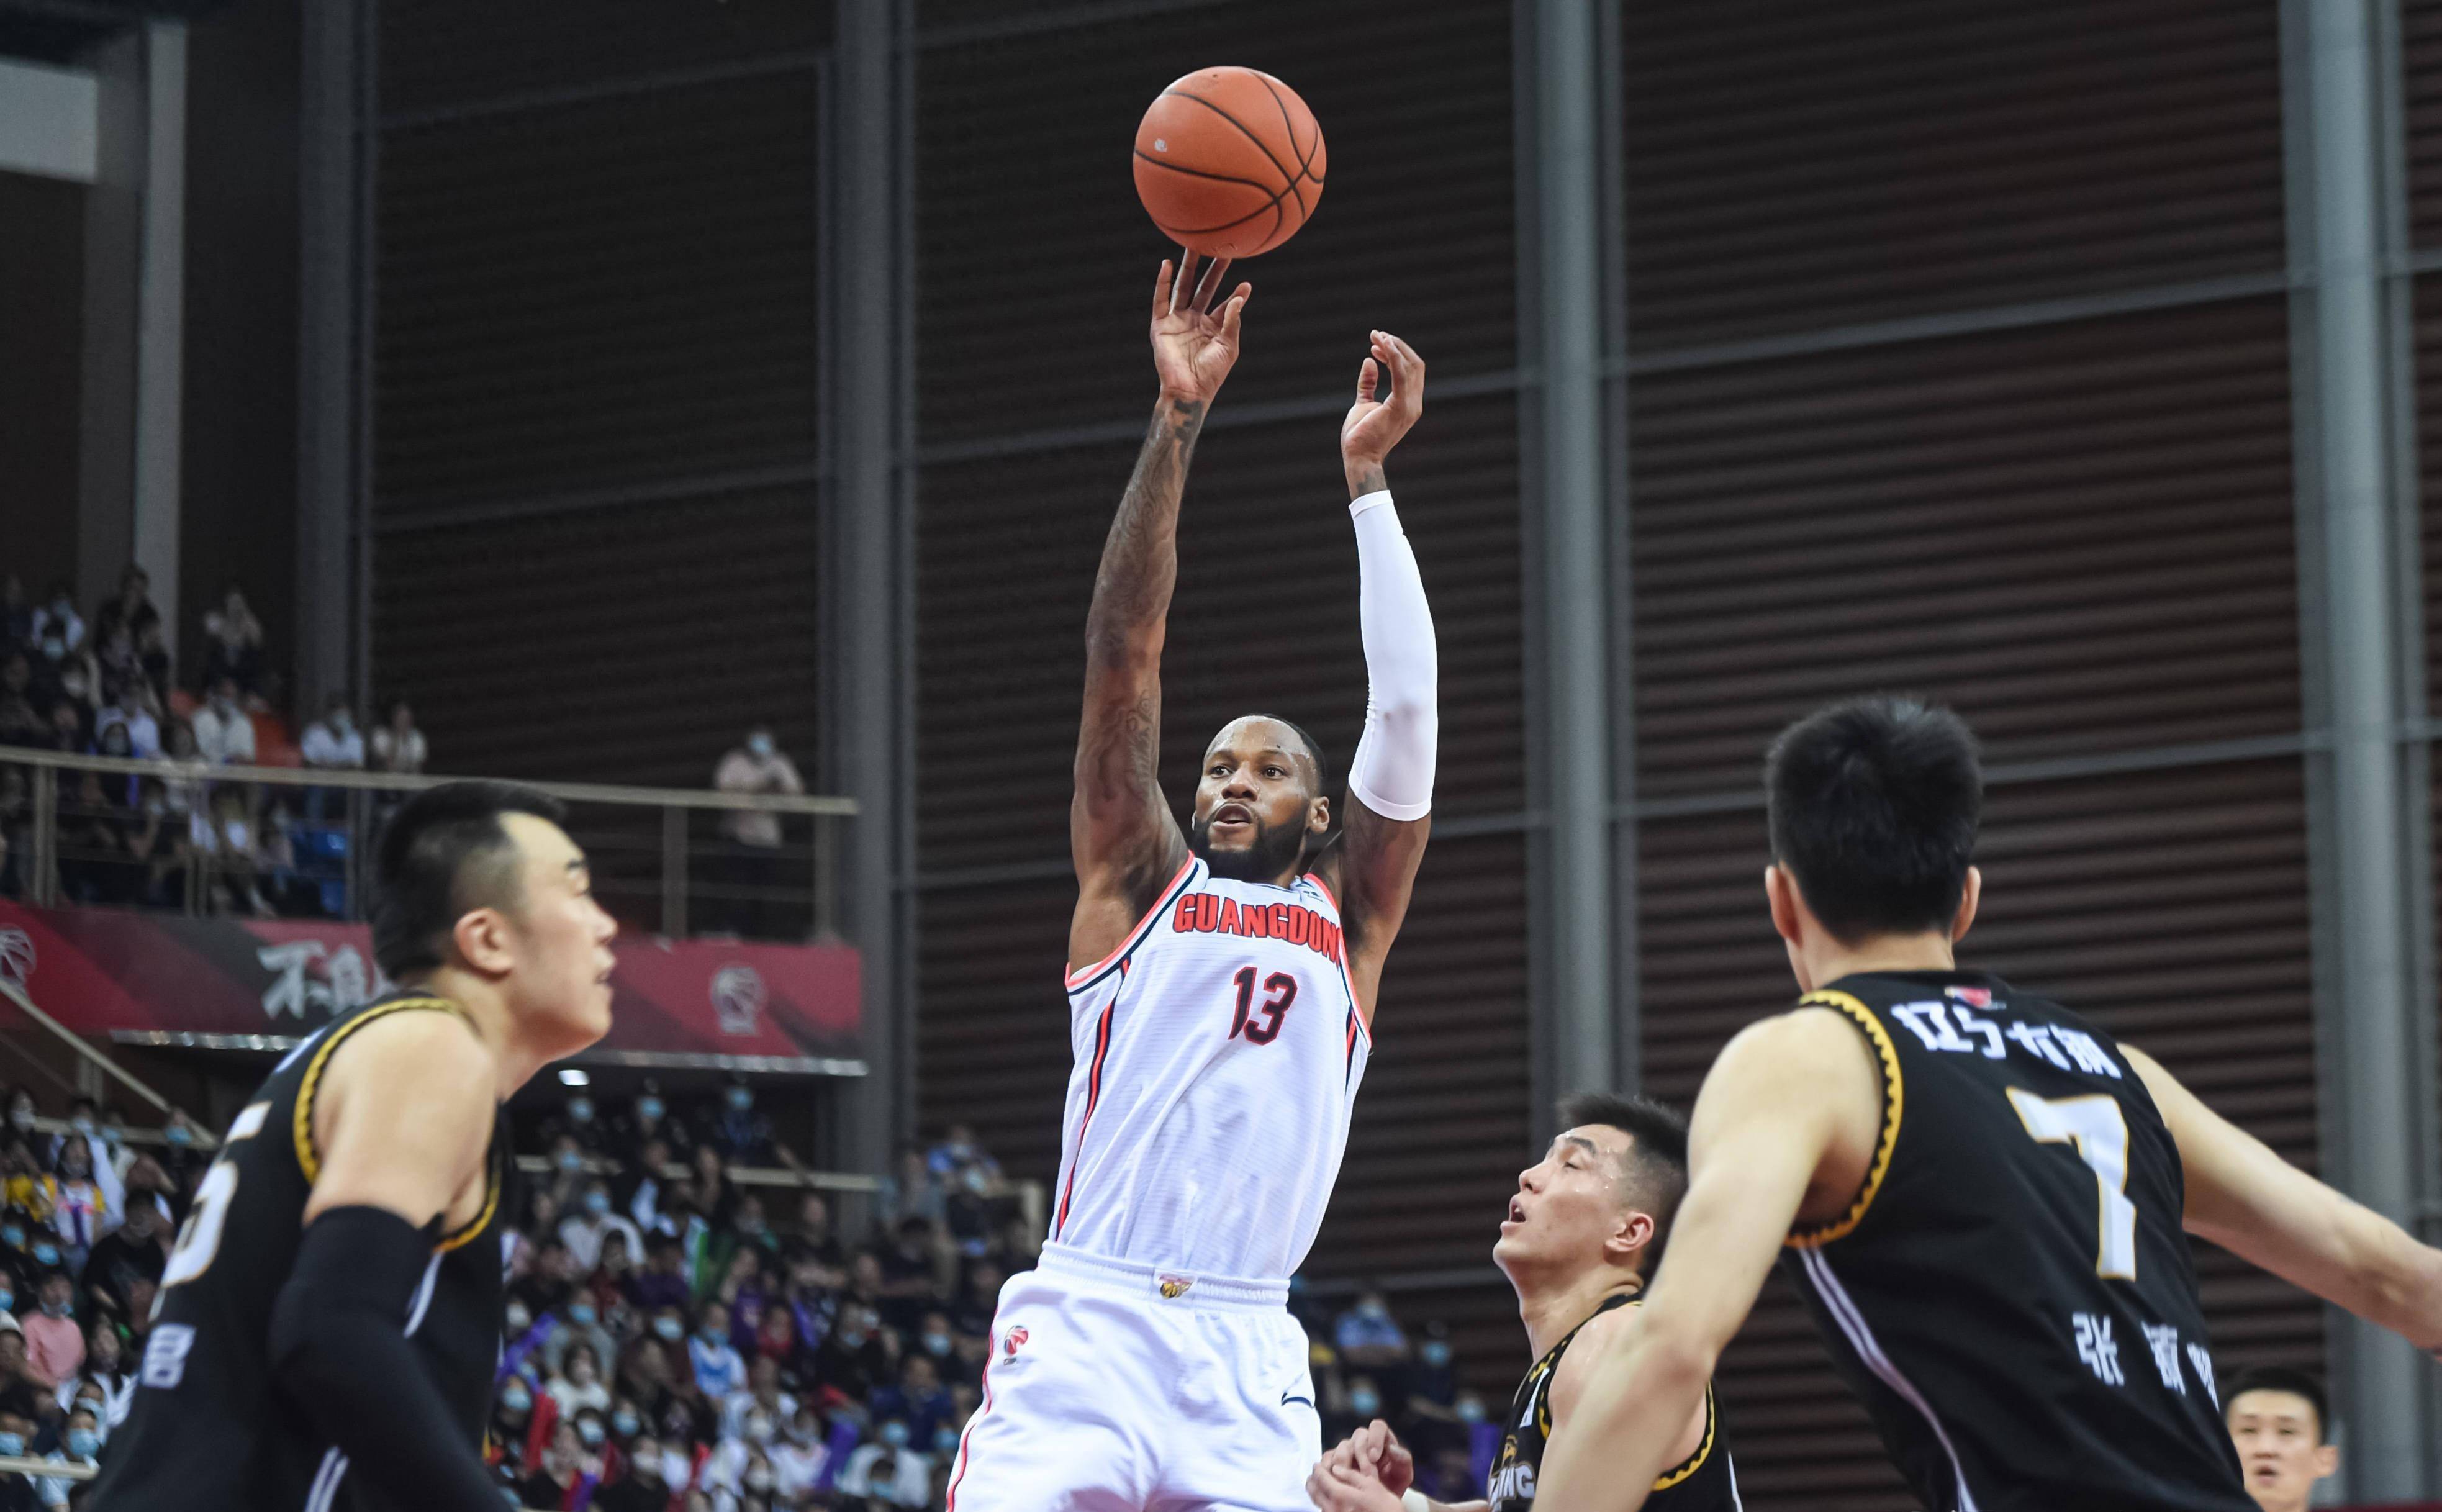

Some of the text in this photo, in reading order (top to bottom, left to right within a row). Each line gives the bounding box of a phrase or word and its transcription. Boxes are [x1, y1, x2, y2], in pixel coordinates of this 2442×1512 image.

[1172, 893, 1342, 972] GUANGDON
[1228, 966, 1297, 1046] 13
[2006, 1086, 2137, 1283] 7
